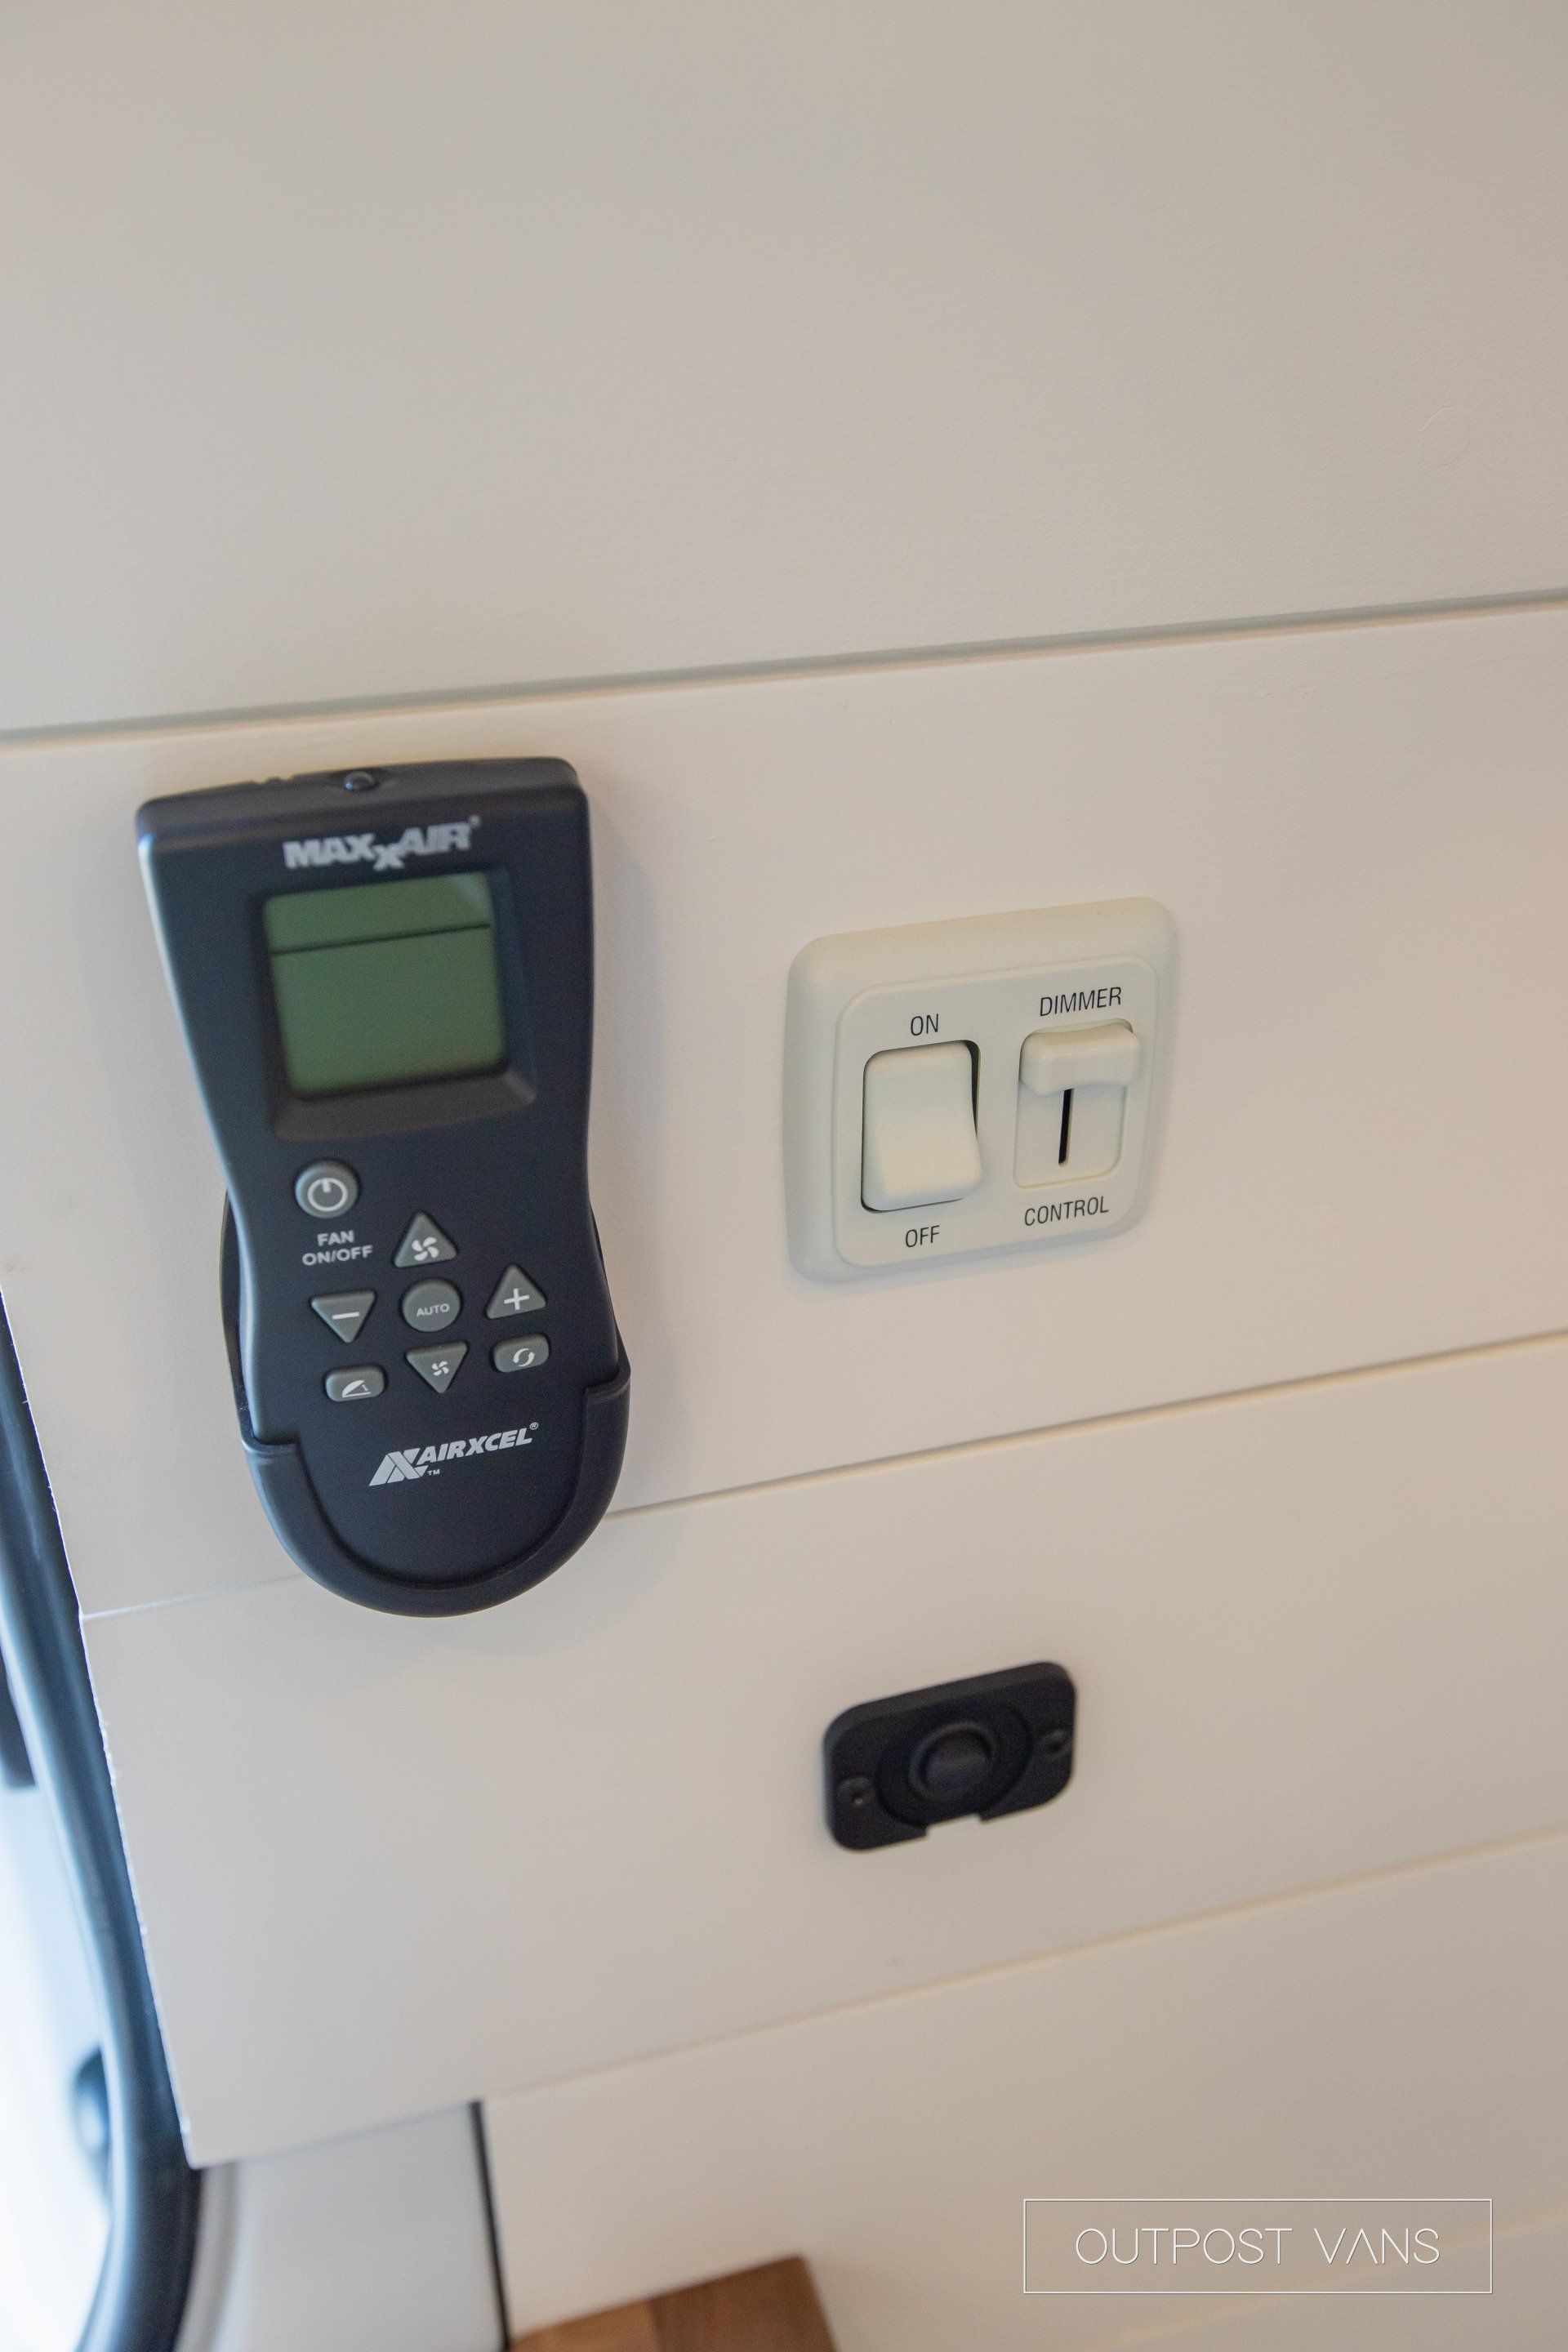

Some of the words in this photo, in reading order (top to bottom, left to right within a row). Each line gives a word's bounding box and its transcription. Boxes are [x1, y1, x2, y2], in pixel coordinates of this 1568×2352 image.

[1040, 987, 1123, 1017] DIMMER
[910, 1013, 939, 1036] ON
[1024, 1196, 1110, 1226] CONTROL
[317, 1230, 354, 1246] FAN
[905, 1225, 940, 1248] OFF
[301, 1245, 373, 1266] ON/OFF
[416, 1303, 450, 1317] AUTO
[416, 1428, 532, 1466] AIRXCEL
